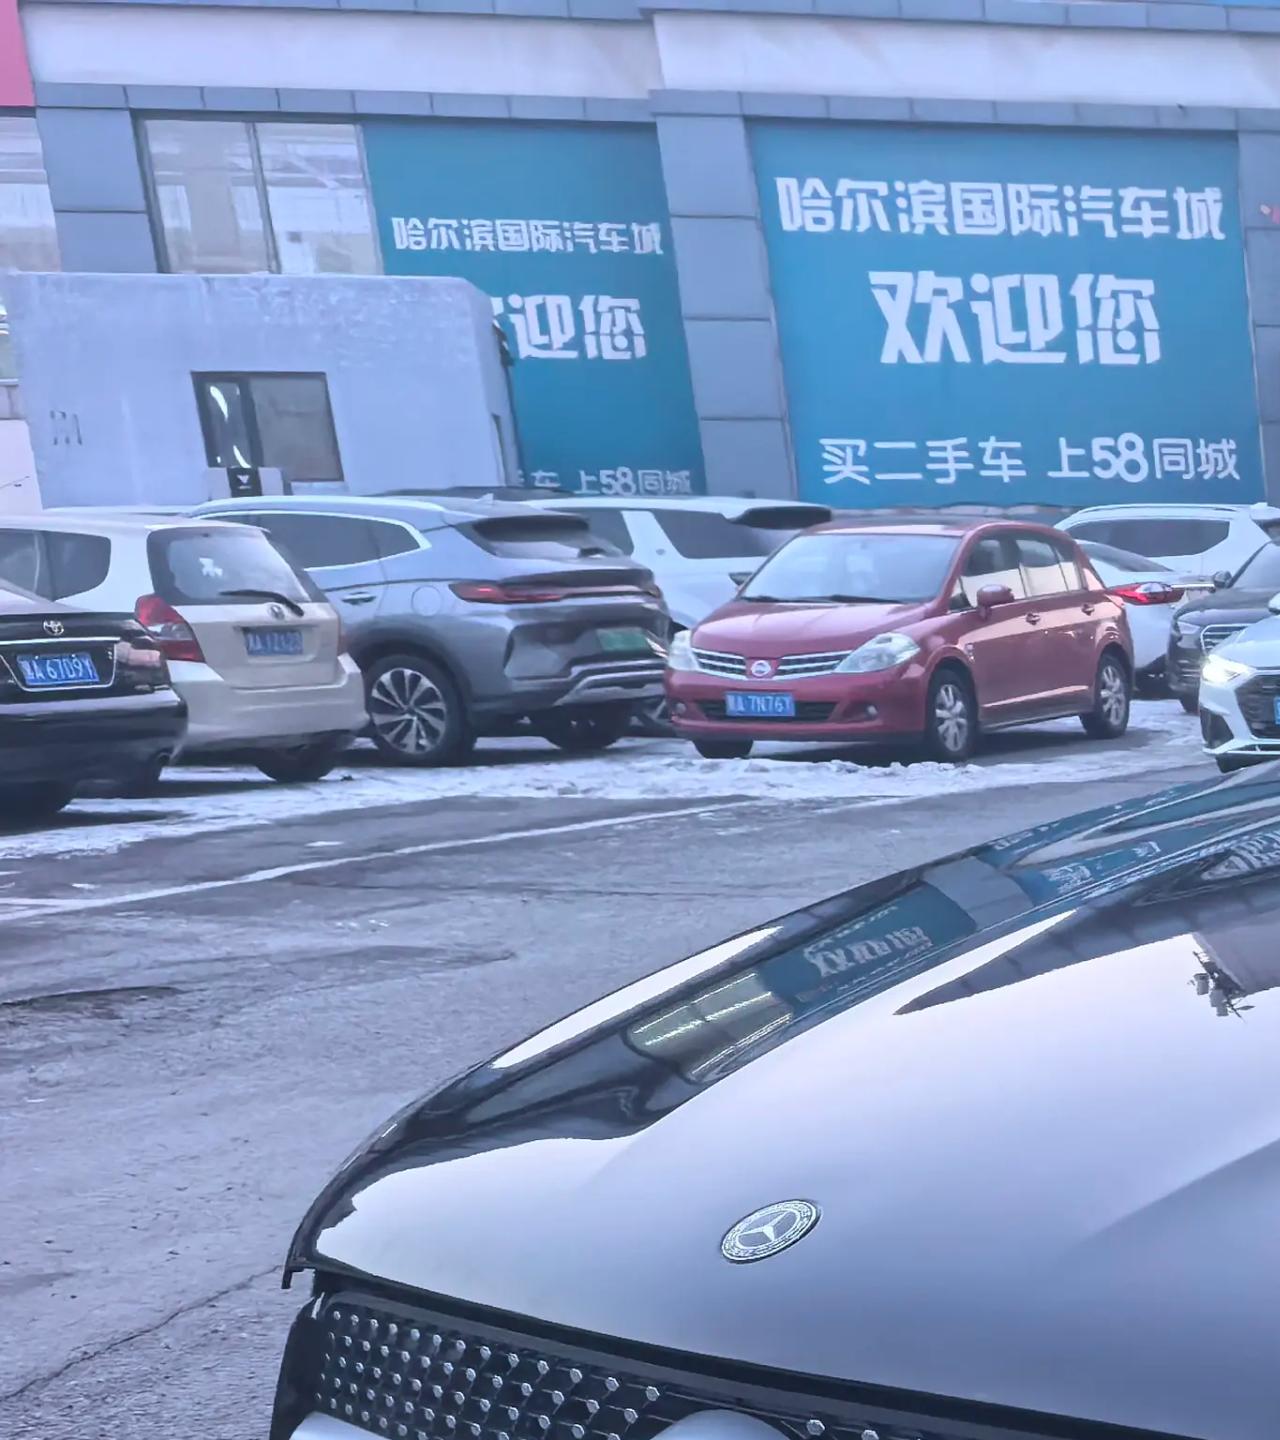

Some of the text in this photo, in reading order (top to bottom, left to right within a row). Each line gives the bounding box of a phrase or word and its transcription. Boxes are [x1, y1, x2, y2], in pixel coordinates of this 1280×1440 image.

[391, 217, 664, 254] 哈尔滨国际汽车城
[774, 176, 1226, 240] 哈尔滨国际汽车城
[489, 293, 647, 360] 迎您
[868, 270, 1161, 364] 欢迎您
[818, 432, 1240, 484] 买二手车 上58同城
